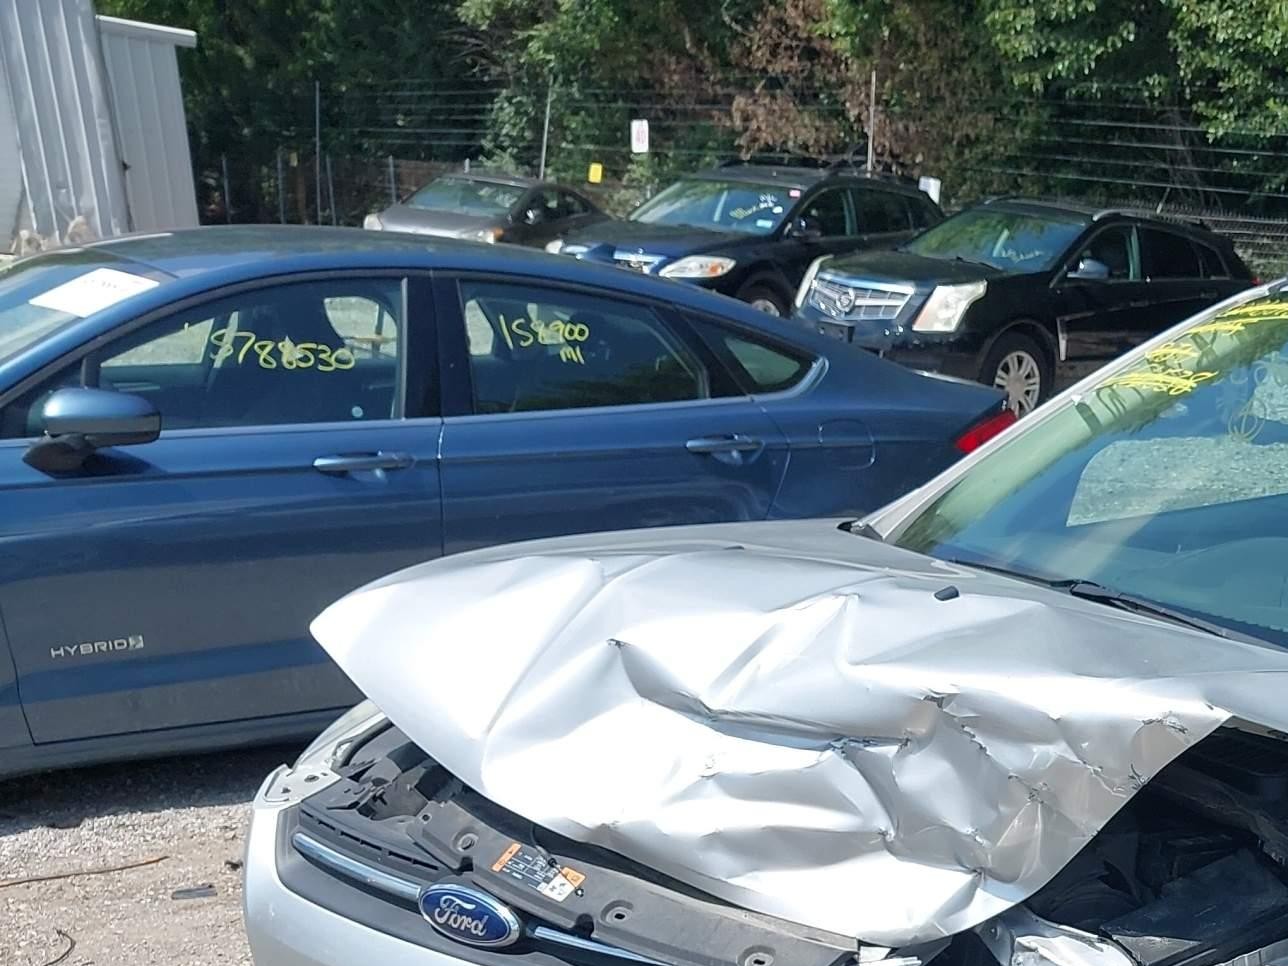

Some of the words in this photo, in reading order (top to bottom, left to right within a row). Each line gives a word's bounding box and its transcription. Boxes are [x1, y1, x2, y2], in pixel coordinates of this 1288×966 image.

[184, 322, 356, 372] 5788530
[50, 639, 128, 659] HYBRID
[434, 895, 489, 937] Ford
